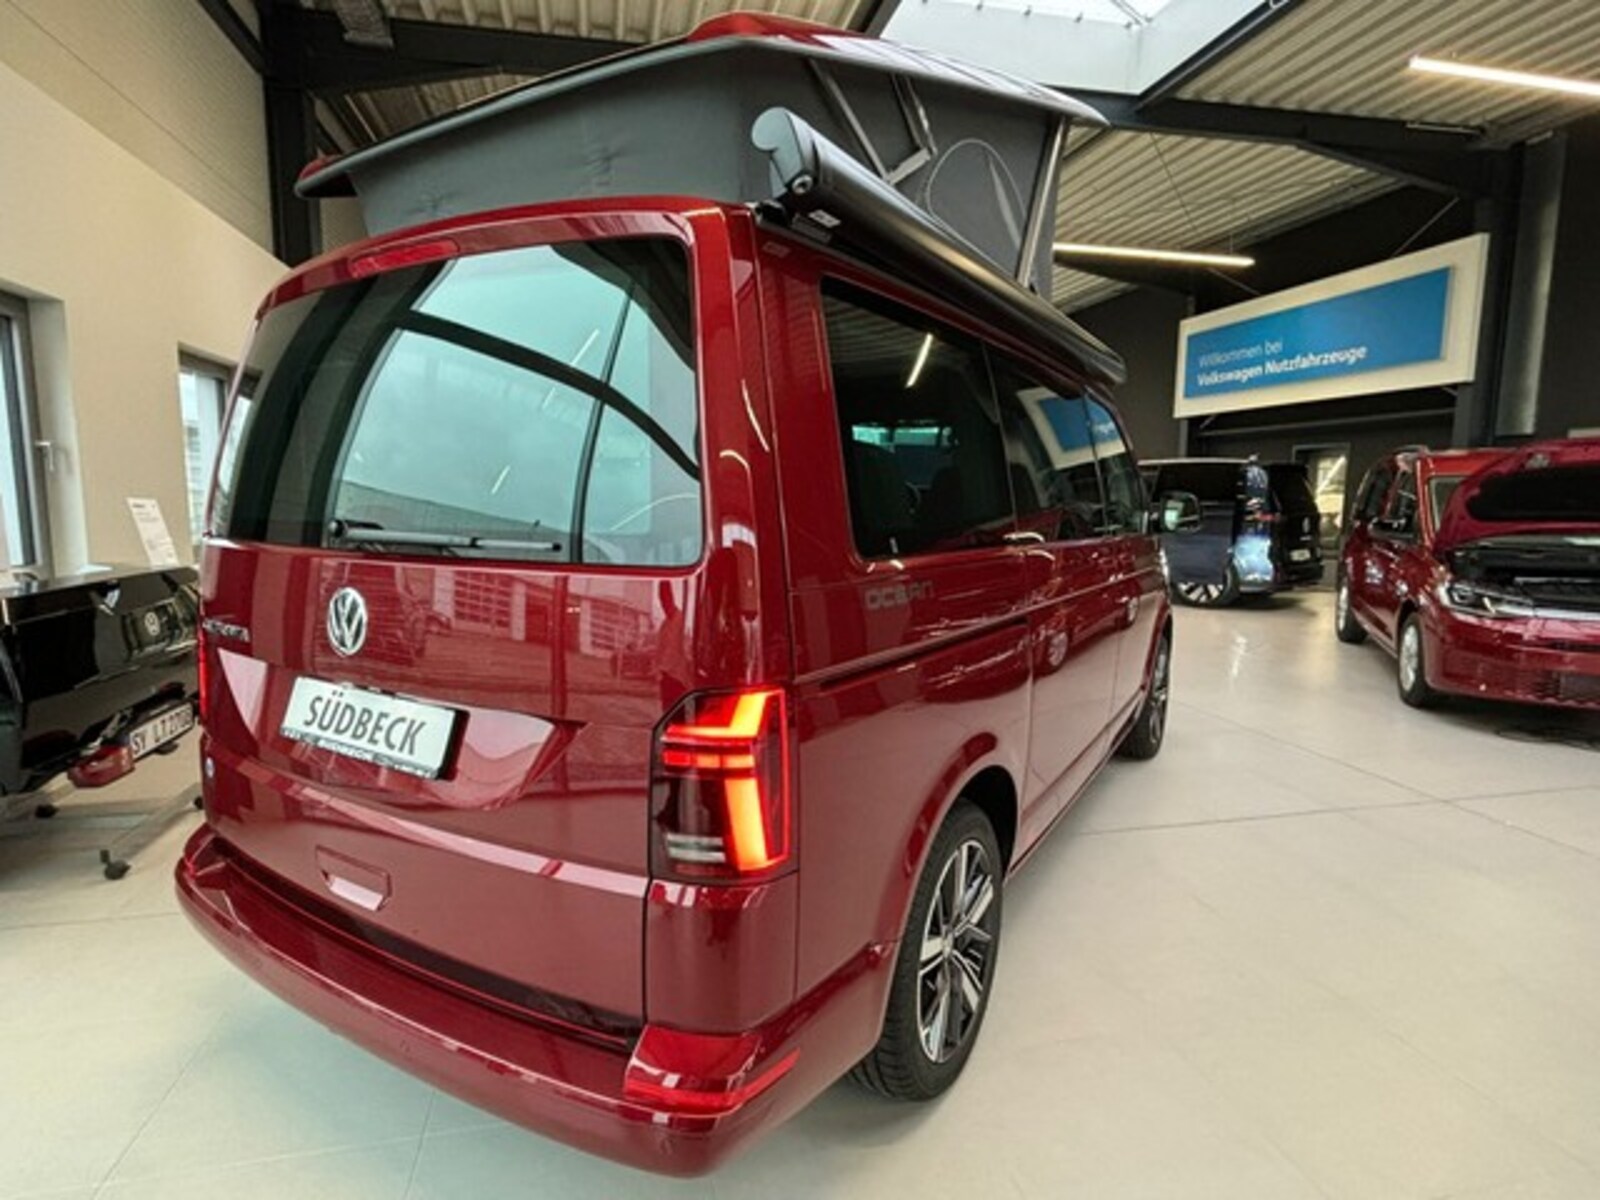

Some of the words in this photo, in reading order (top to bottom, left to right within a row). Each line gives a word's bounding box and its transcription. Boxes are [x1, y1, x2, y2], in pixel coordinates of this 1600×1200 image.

[1197, 365, 1262, 387] Volkswagen
[1264, 346, 1367, 375] Nutzfahrzeuge
[1199, 345, 1262, 368] Willkommen
[1264, 337, 1283, 356] bei
[303, 690, 427, 756] SÜDBECK
